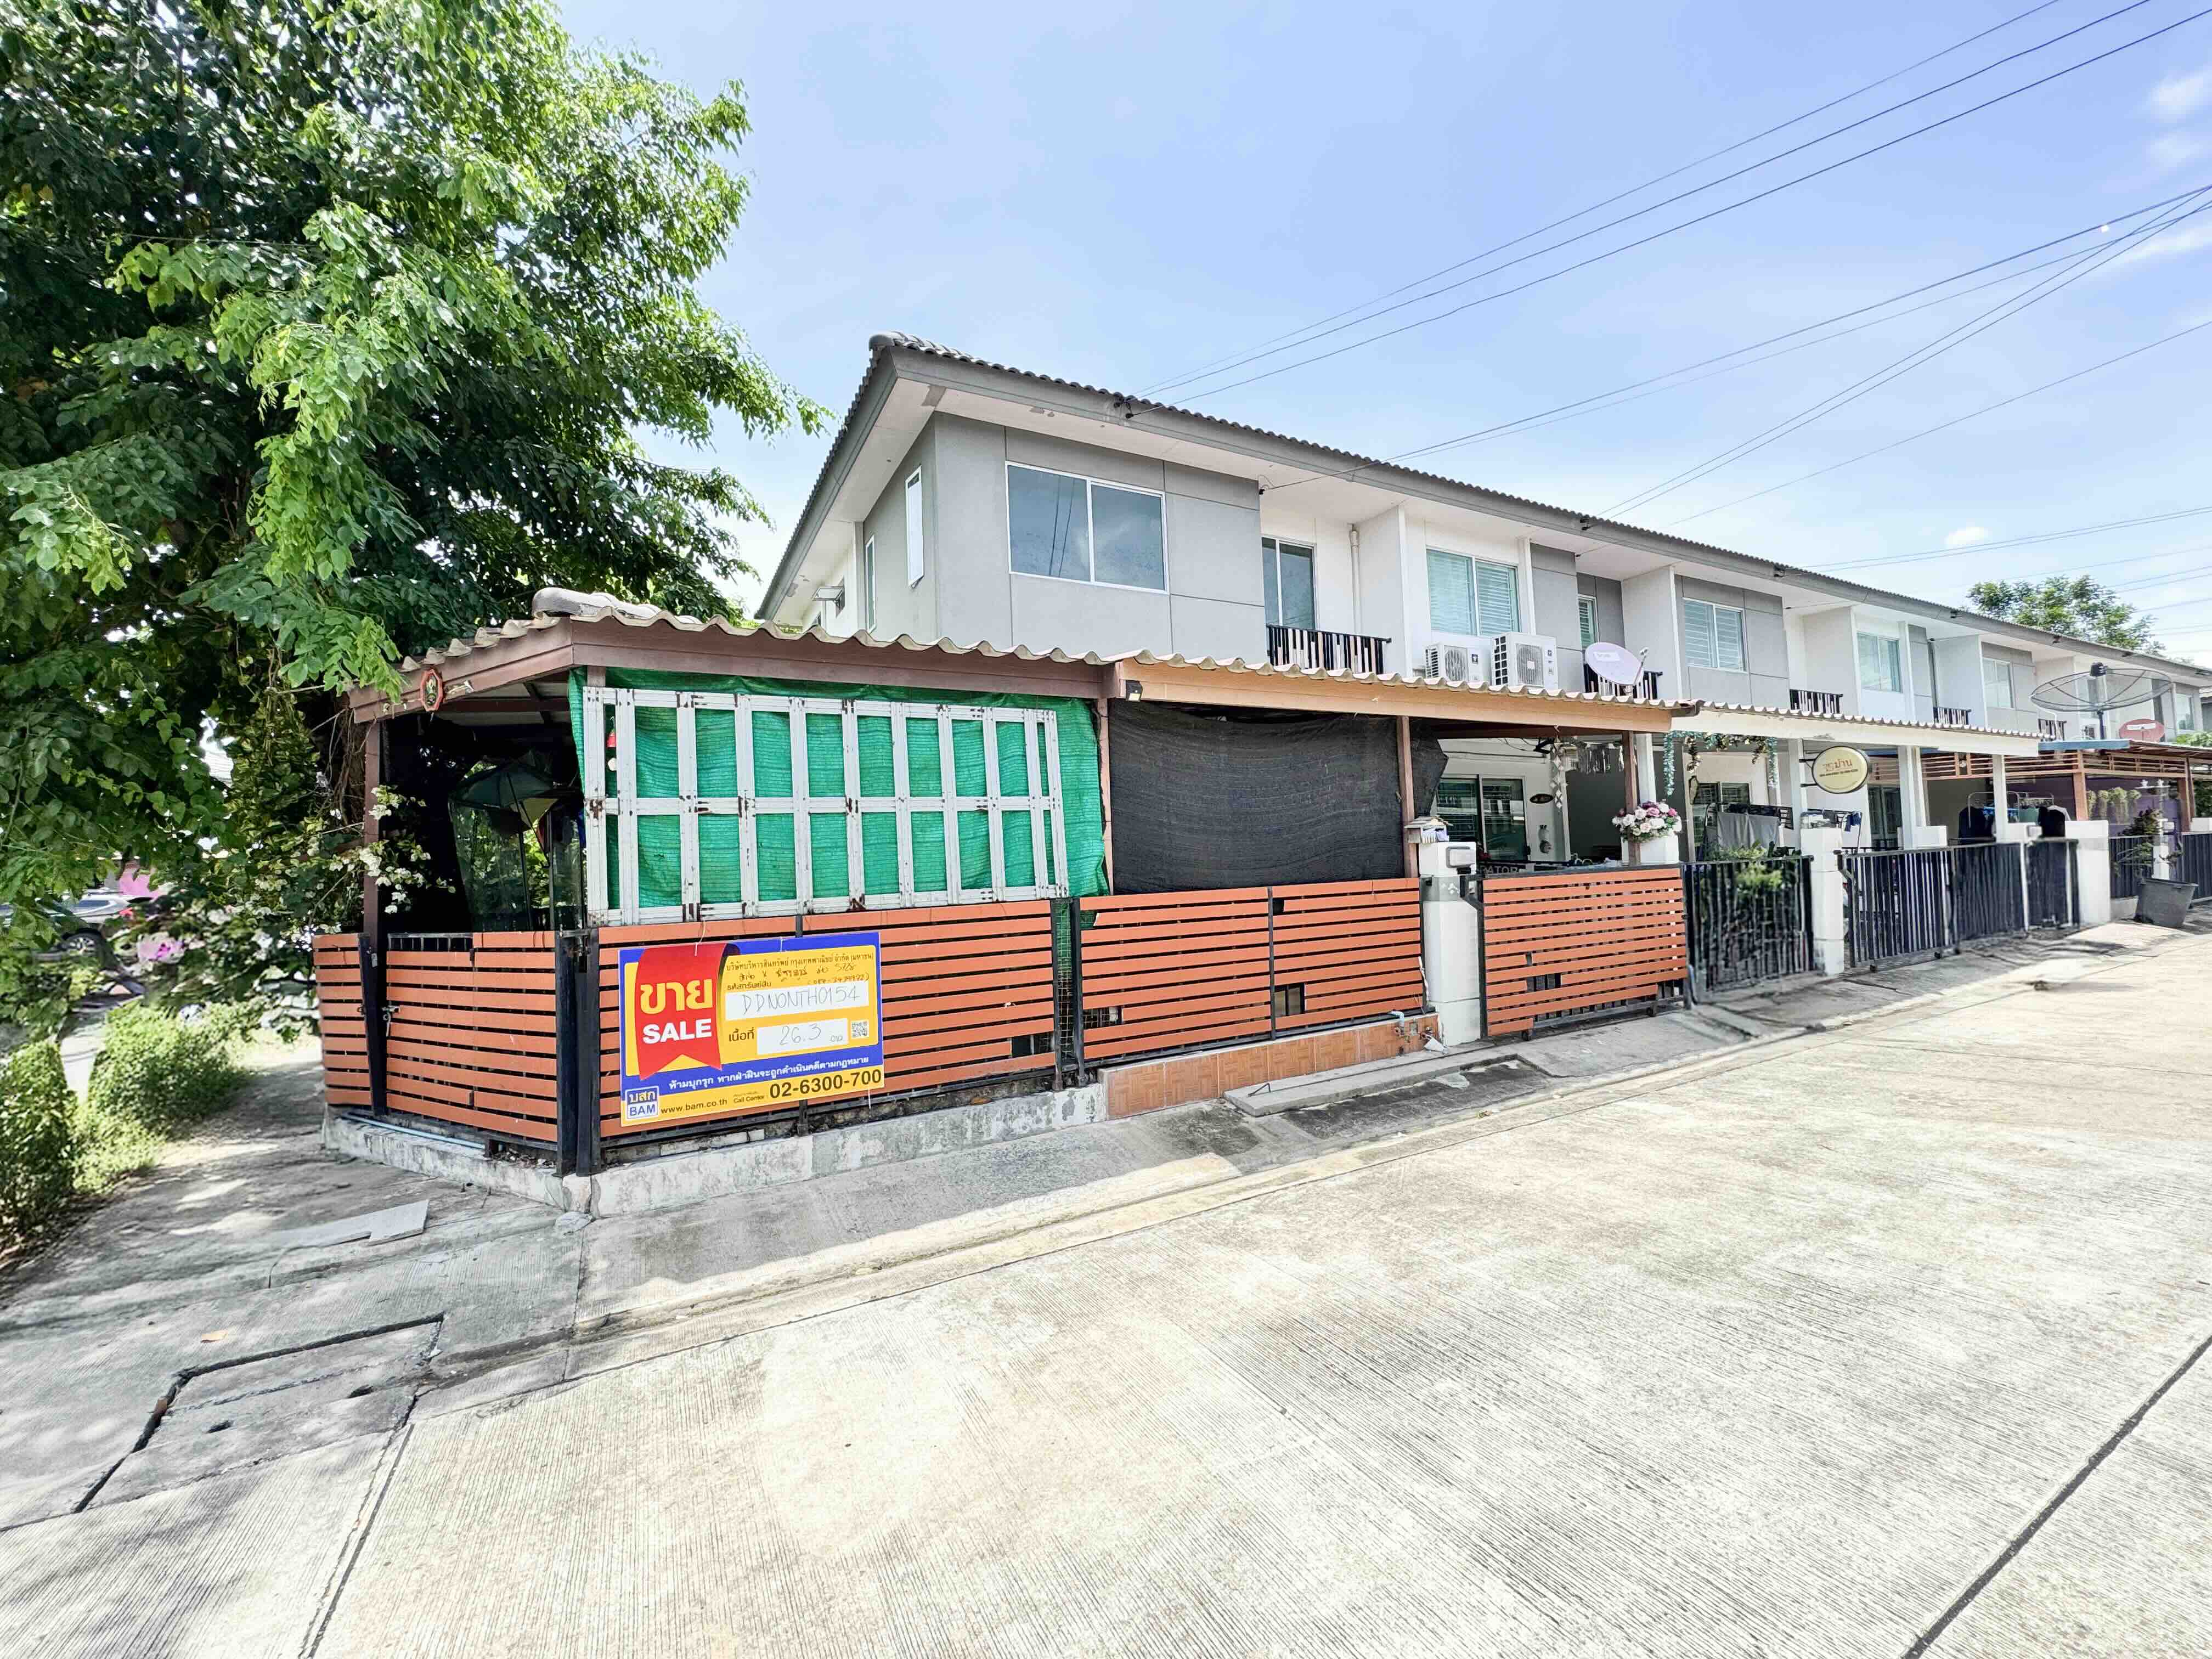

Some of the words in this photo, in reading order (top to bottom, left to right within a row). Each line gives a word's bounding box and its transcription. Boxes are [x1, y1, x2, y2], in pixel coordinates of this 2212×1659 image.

[726, 957, 789, 970] บริษัทบริหารสินทรัพย์
[834, 952, 849, 964] จำกัด
[727, 980, 771, 991] รหัสทรัพย์สิน
[640, 979, 713, 1014] ขาย
[643, 1018, 712, 1044] SALE
[729, 1026, 755, 1042] เนื้อที่
[780, 1024, 822, 1045] 26.3
[669, 1077, 714, 1090] ห้ามบุกรุก
[770, 1069, 882, 1098] 02-6300-700
[629, 1091, 656, 1102] บสก
[630, 1104, 655, 1115] BAM
[661, 1099, 727, 1114] www.bam.co.th
